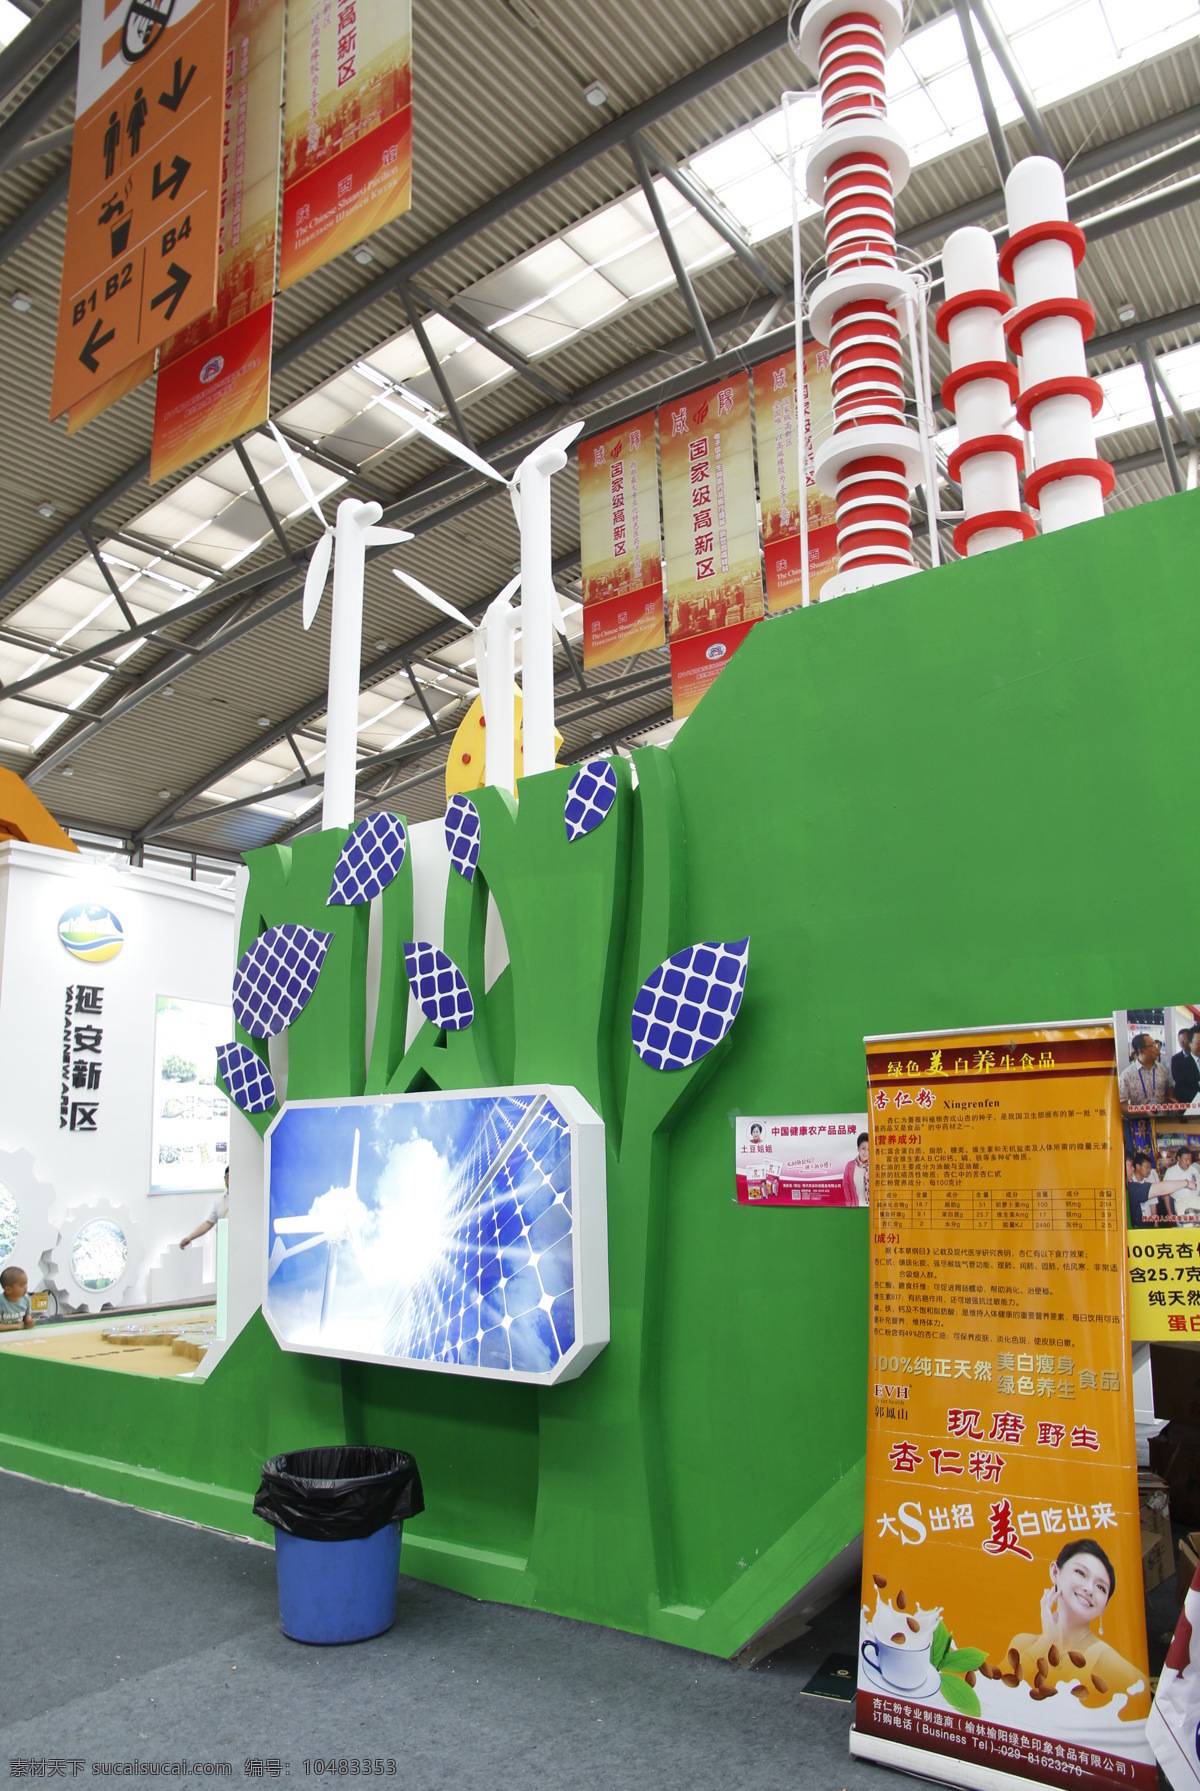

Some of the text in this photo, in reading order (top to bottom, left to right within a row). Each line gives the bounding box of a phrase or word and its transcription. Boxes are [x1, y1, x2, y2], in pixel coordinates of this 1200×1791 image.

[336, 0, 357, 88] 高新区
[309, 207, 336, 229] Chinese
[367, 165, 399, 190] Pavilion
[161, 214, 192, 257] B4
[72, 262, 133, 326] B1 B2
[610, 459, 627, 557] 国家级高新区
[688, 435, 716, 582] 国家级高新区
[70, 984, 105, 1131] 延安新区
[887, 1050, 1055, 1078] 绿色美白养生食品
[874, 1087, 936, 1110] 杏仁粉
[943, 1099, 1000, 1111] Xingrenfen
[771, 1124, 857, 1136] 中国健康农产品品牌
[741, 1144, 773, 1154] 土豆姐姐
[1127, 1242, 1200, 1260] 100克杏
[1129, 1266, 1200, 1283] 含25.7克
[1148, 1289, 1200, 1307] 纯天然
[873, 1355, 992, 1381] 100%纯正天然
[997, 1352, 1075, 1376] 美白瘦身
[874, 1384, 910, 1400] EVH
[997, 1375, 1076, 1399] 绿色养生
[1078, 1369, 1120, 1391] 食品
[947, 1408, 1100, 1451] 现磨野生
[889, 1440, 1006, 1484] 杏仁粉
[876, 1501, 975, 1546] 大S出招
[981, 1498, 1119, 1561] 美白吃出来
